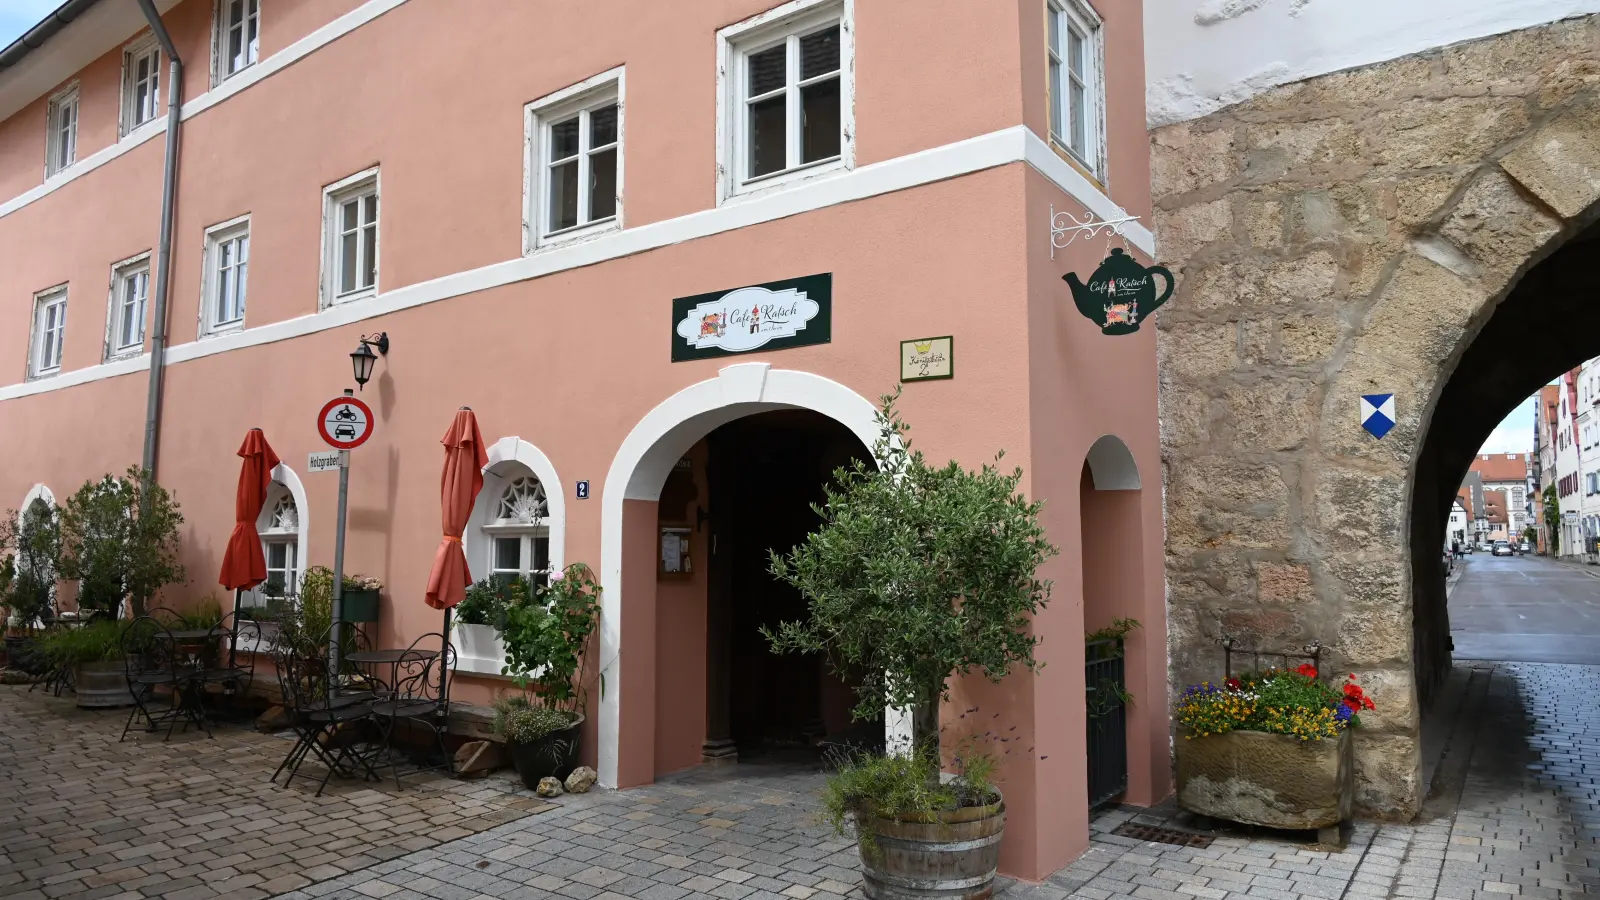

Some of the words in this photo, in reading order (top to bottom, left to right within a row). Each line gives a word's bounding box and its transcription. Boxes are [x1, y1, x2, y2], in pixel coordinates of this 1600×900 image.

[1116, 276, 1147, 289] Ratsch
[761, 301, 797, 320] Ratsch
[579, 483, 585, 496] 2
